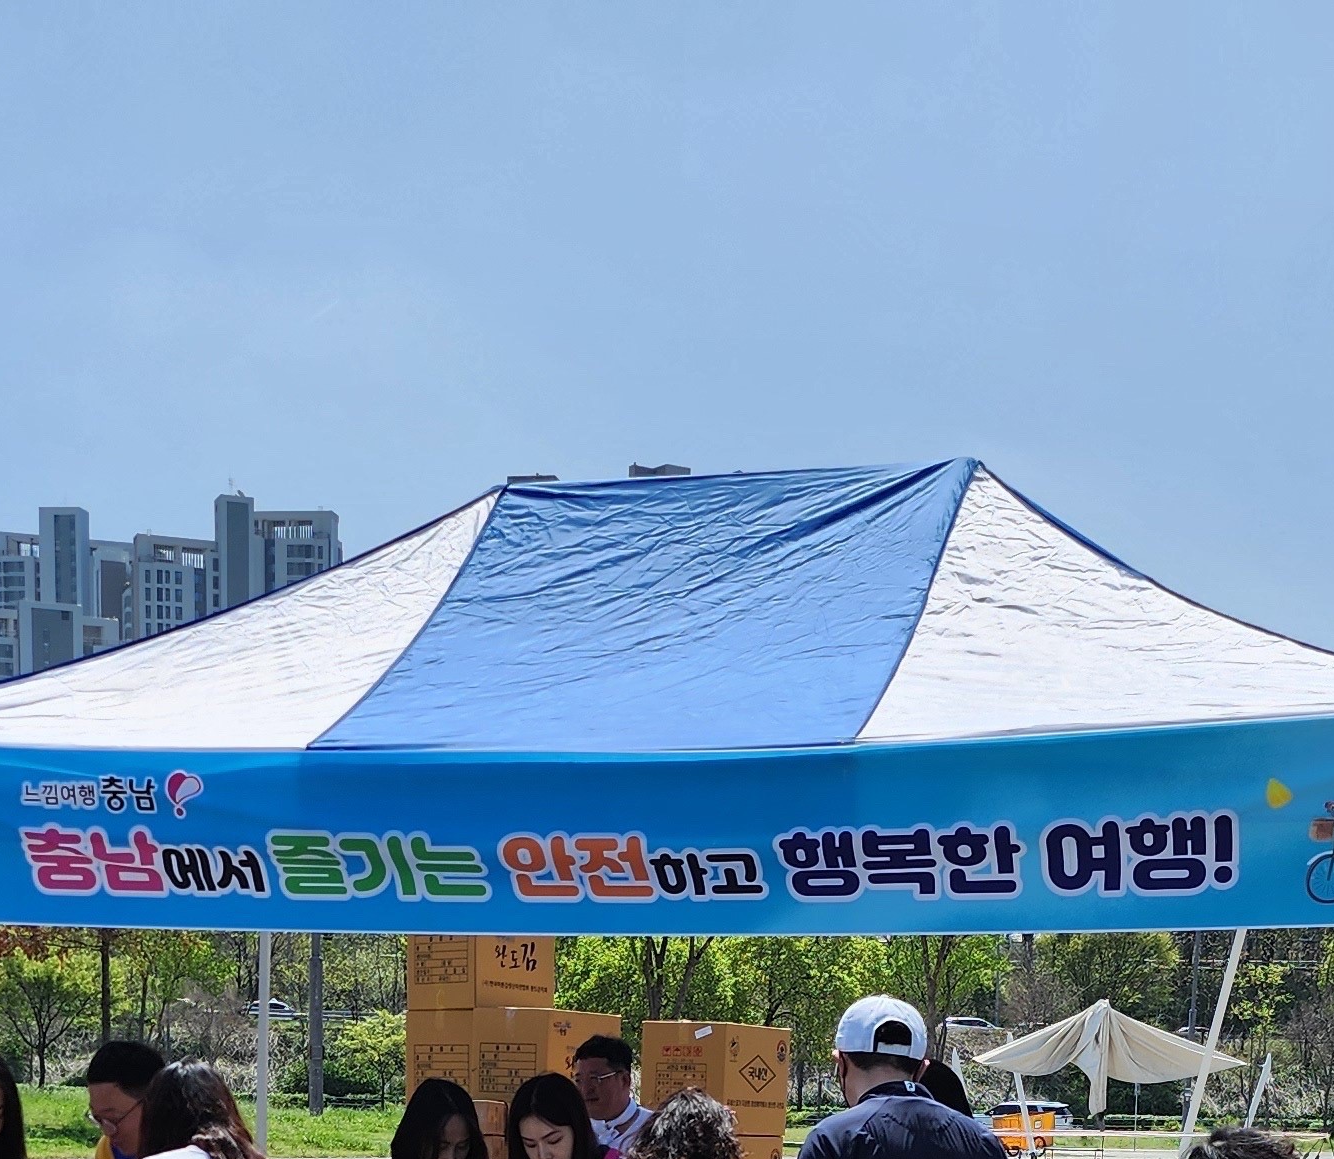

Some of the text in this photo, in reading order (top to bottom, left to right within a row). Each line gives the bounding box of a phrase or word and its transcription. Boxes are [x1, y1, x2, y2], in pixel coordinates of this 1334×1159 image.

[21, 774, 156, 813] 느낌여행 충남
[23, 812, 1238, 900] 충남에서 즐기는 안전하고 행복한 여행!
[494, 941, 538, 972] 완도김
[747, 1066, 768, 1082] 국내산
